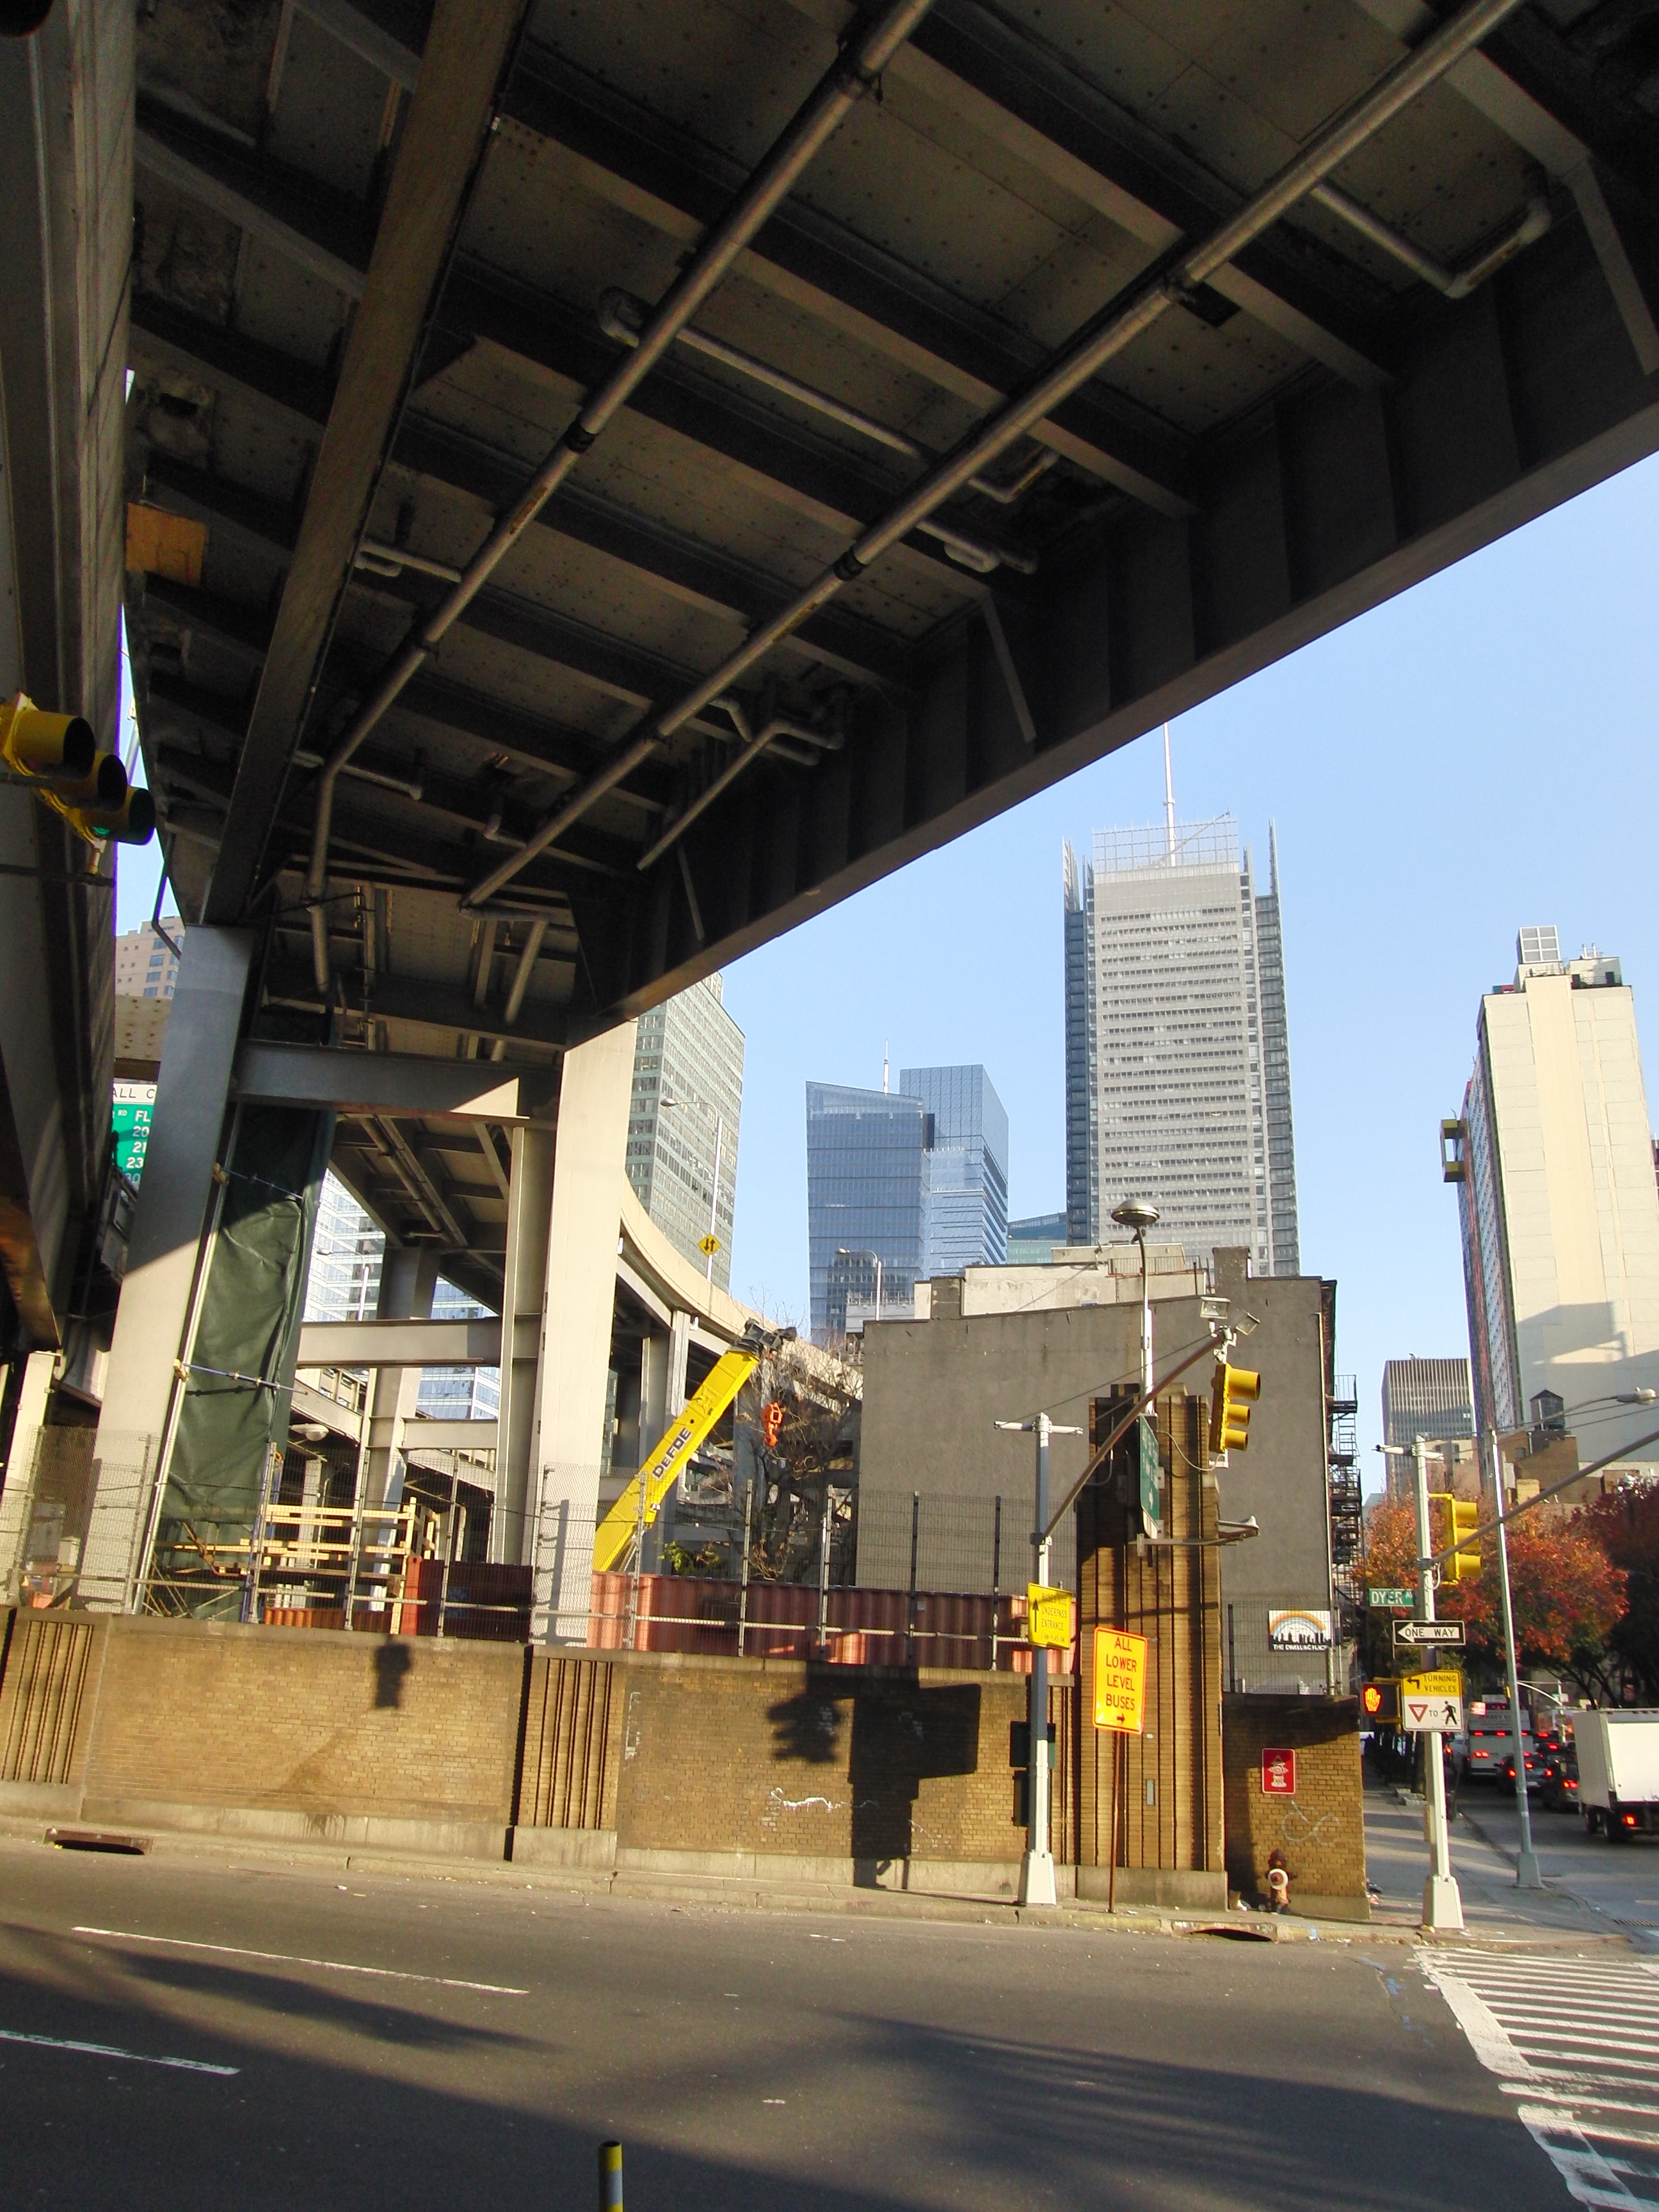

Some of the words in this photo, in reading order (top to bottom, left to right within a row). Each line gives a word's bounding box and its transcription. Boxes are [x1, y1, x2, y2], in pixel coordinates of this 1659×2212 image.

[132, 1126, 150, 1137] 20
[125, 1157, 144, 1169] 23
[1372, 1591, 1404, 1605] DYER
[1041, 1606, 1068, 1619] UNDERPASS
[1041, 1618, 1064, 1631] ENTRANCE
[1405, 1628, 1425, 1637] ONE
[1434, 1628, 1455, 1637] WAY
[1114, 1637, 1132, 1652] ALL
[1105, 1653, 1137, 1672] LOWER
[1107, 1673, 1135, 1692] LEVEL
[1423, 1674, 1457, 1683] TURNING
[1424, 1685, 1457, 1693] VEHICLES
[1105, 1693, 1135, 1711] BUSES
